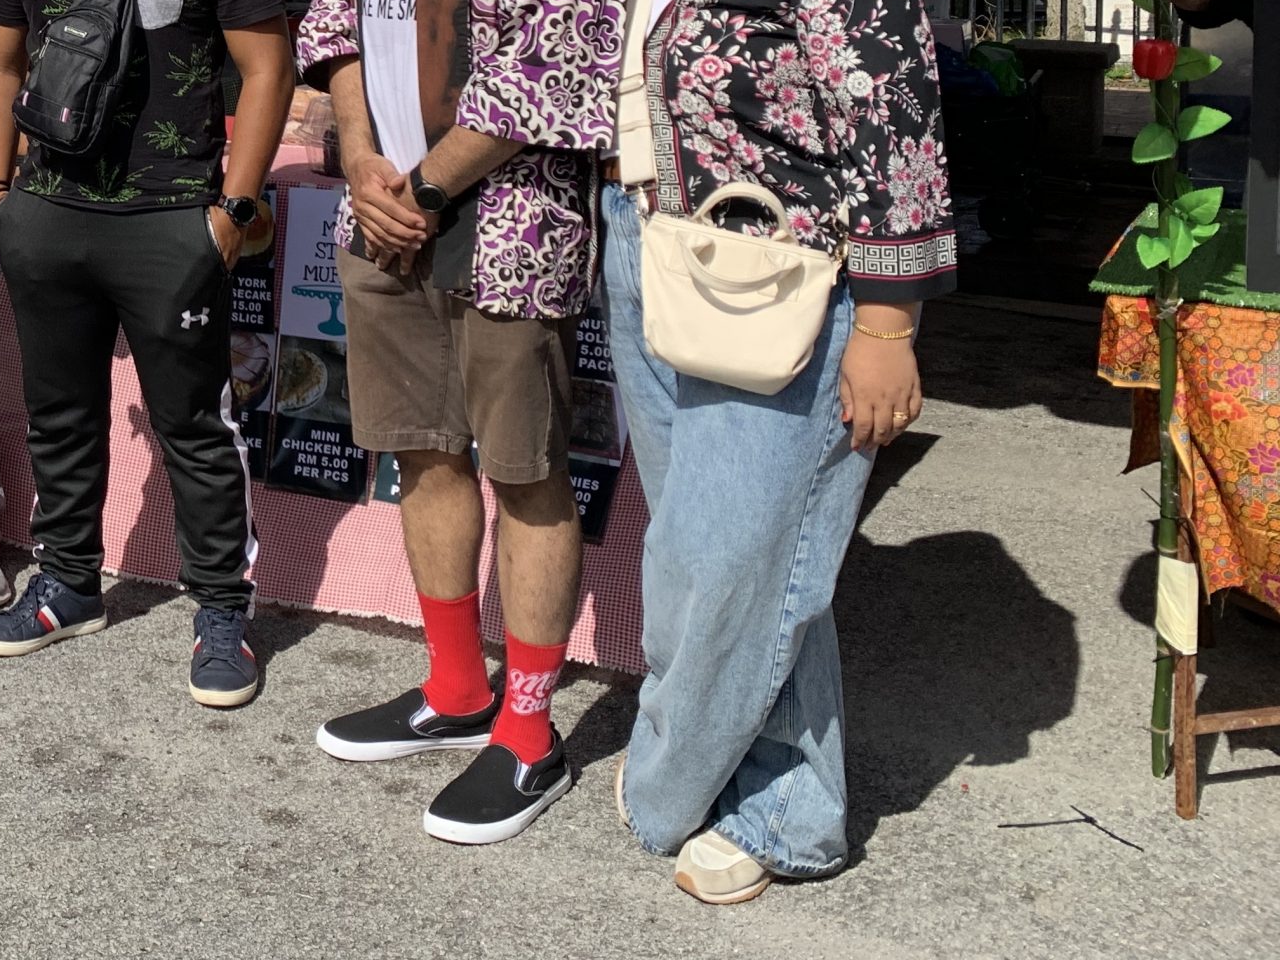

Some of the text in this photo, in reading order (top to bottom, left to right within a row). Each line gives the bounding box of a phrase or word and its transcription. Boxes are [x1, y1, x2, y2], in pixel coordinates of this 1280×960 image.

[322, 220, 338, 237] M
[303, 264, 342, 284] MUF
[237, 276, 267, 290] YORK
[232, 300, 262, 312] 15.00
[231, 311, 265, 325] SLICE
[580, 344, 611, 358] 5.00
[310, 429, 341, 444] MINI
[281, 438, 365, 459] CHICKEN PIE
[297, 453, 349, 470] RM 5.00
[294, 465, 350, 483] PER PCS
